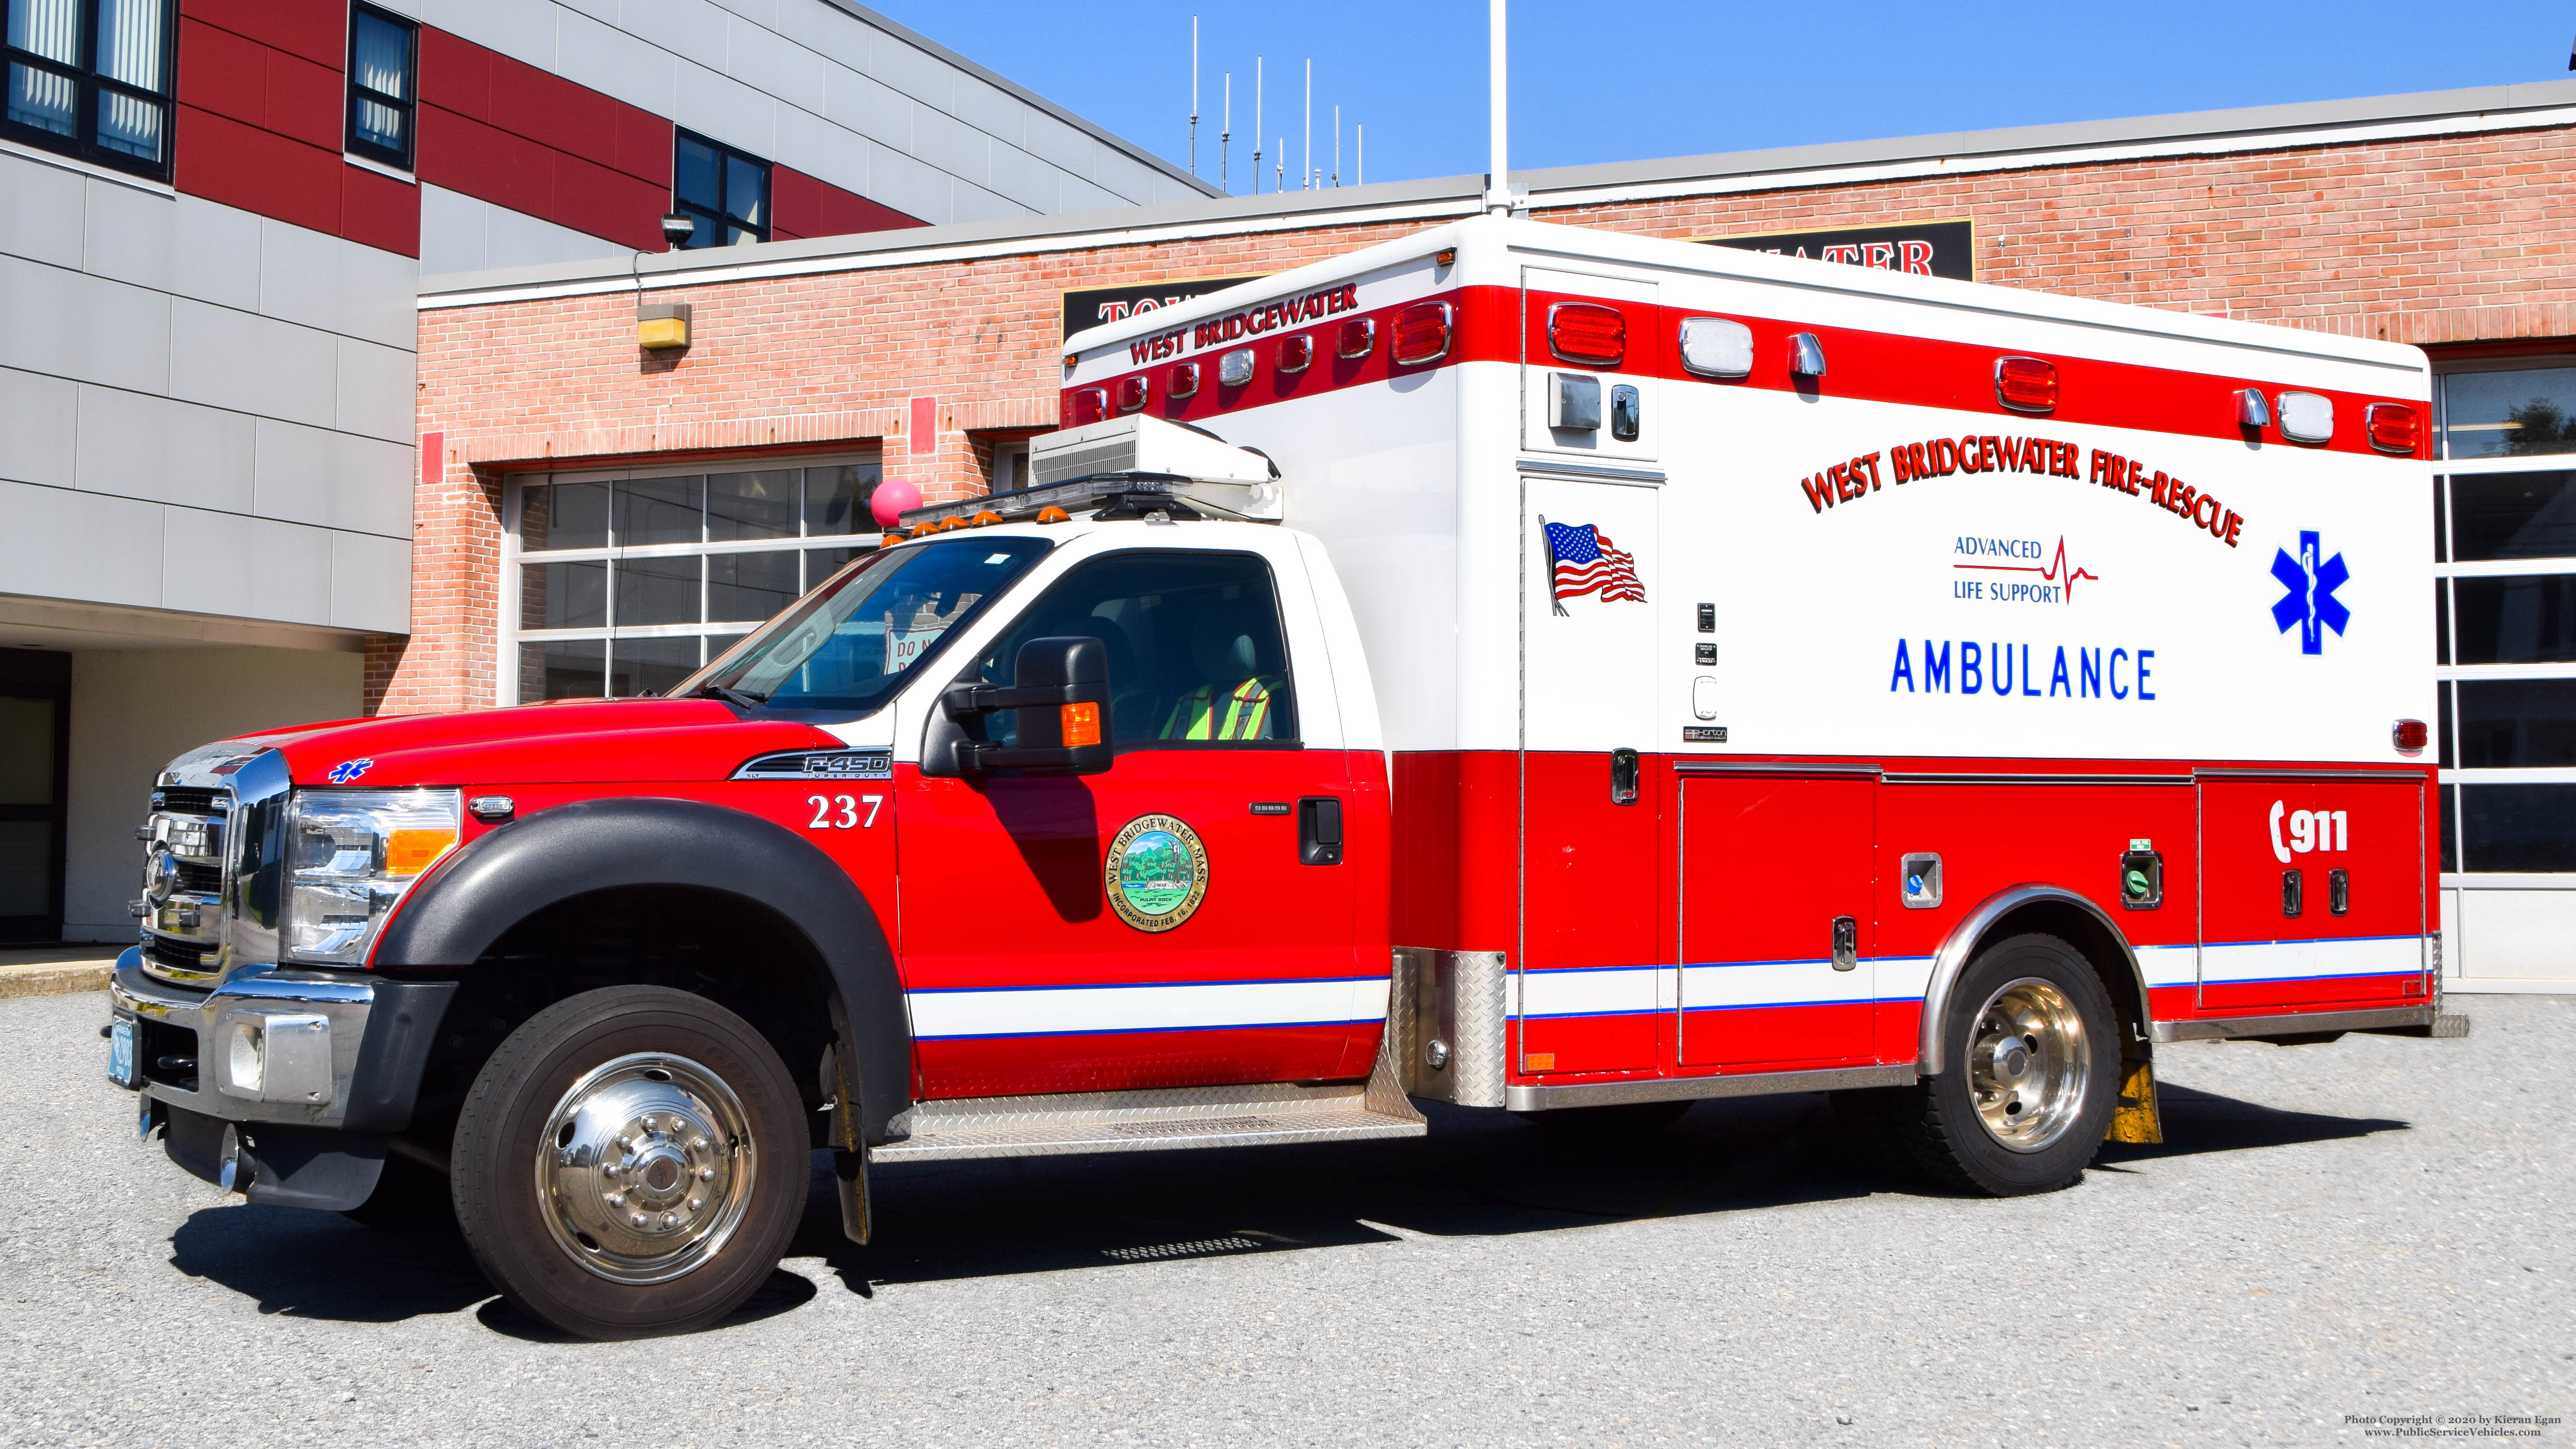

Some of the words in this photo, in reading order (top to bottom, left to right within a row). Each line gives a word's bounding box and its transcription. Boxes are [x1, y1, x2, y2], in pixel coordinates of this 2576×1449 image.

[1130, 328, 1188, 366] WEST
[1194, 283, 1358, 349] BRIDGEWATER
[1801, 452, 1881, 514] WEST
[1891, 435, 2080, 485] BRIDGEWATER
[2091, 448, 2244, 548] FIRE-RESCUE
[1955, 536, 2042, 559] ADVANCED
[1954, 581, 1983, 599] LIFE
[1990, 583, 2061, 604] SUPPORT
[897, 641, 915, 657] DO
[1890, 638, 2156, 700] AMBULANCE
[802, 756, 890, 773] F-450
[807, 795, 883, 829] 237
[2290, 810, 2347, 853] 911
[1109, 848, 1122, 885] WEST
[1119, 818, 1194, 849] BRIDGEWATER,
[1193, 848, 1205, 885] MASS.
[1113, 893, 1159, 927] INCORPORATED
[1161, 916, 1177, 926] FEB.
[1188, 890, 1200, 908] 1822
